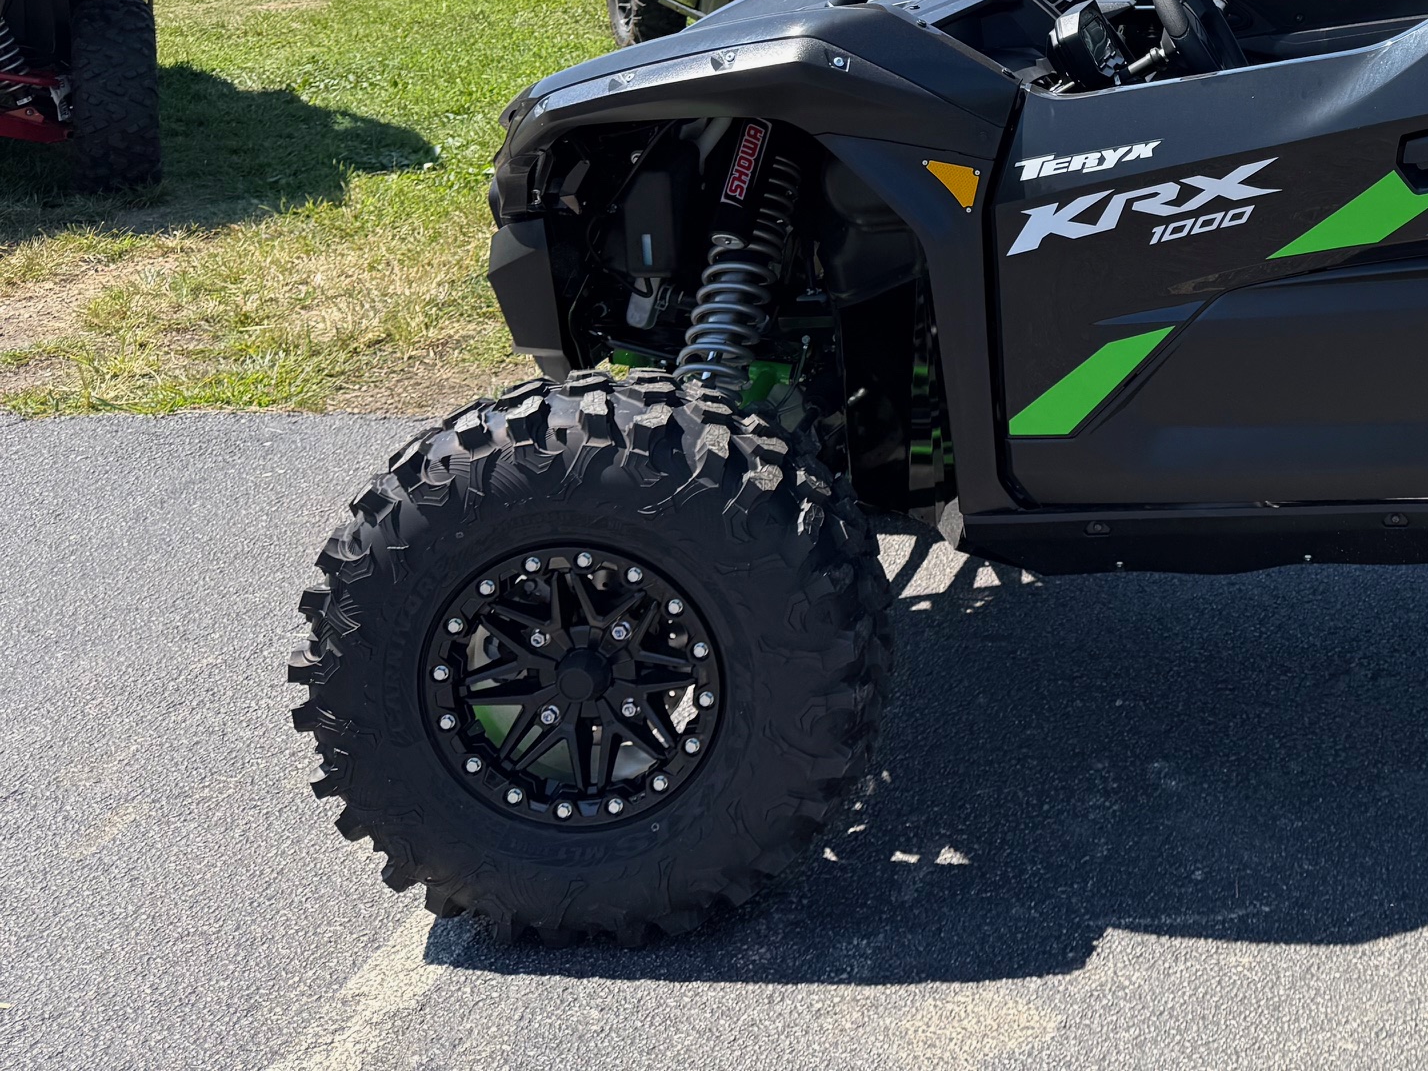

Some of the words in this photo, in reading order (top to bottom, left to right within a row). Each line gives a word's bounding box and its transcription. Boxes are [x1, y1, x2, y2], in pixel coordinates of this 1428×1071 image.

[726, 123, 766, 201] SHOWA
[1014, 138, 1164, 182] TERYX
[1006, 156, 1283, 257] KRX
[1149, 205, 1256, 246] 1000
